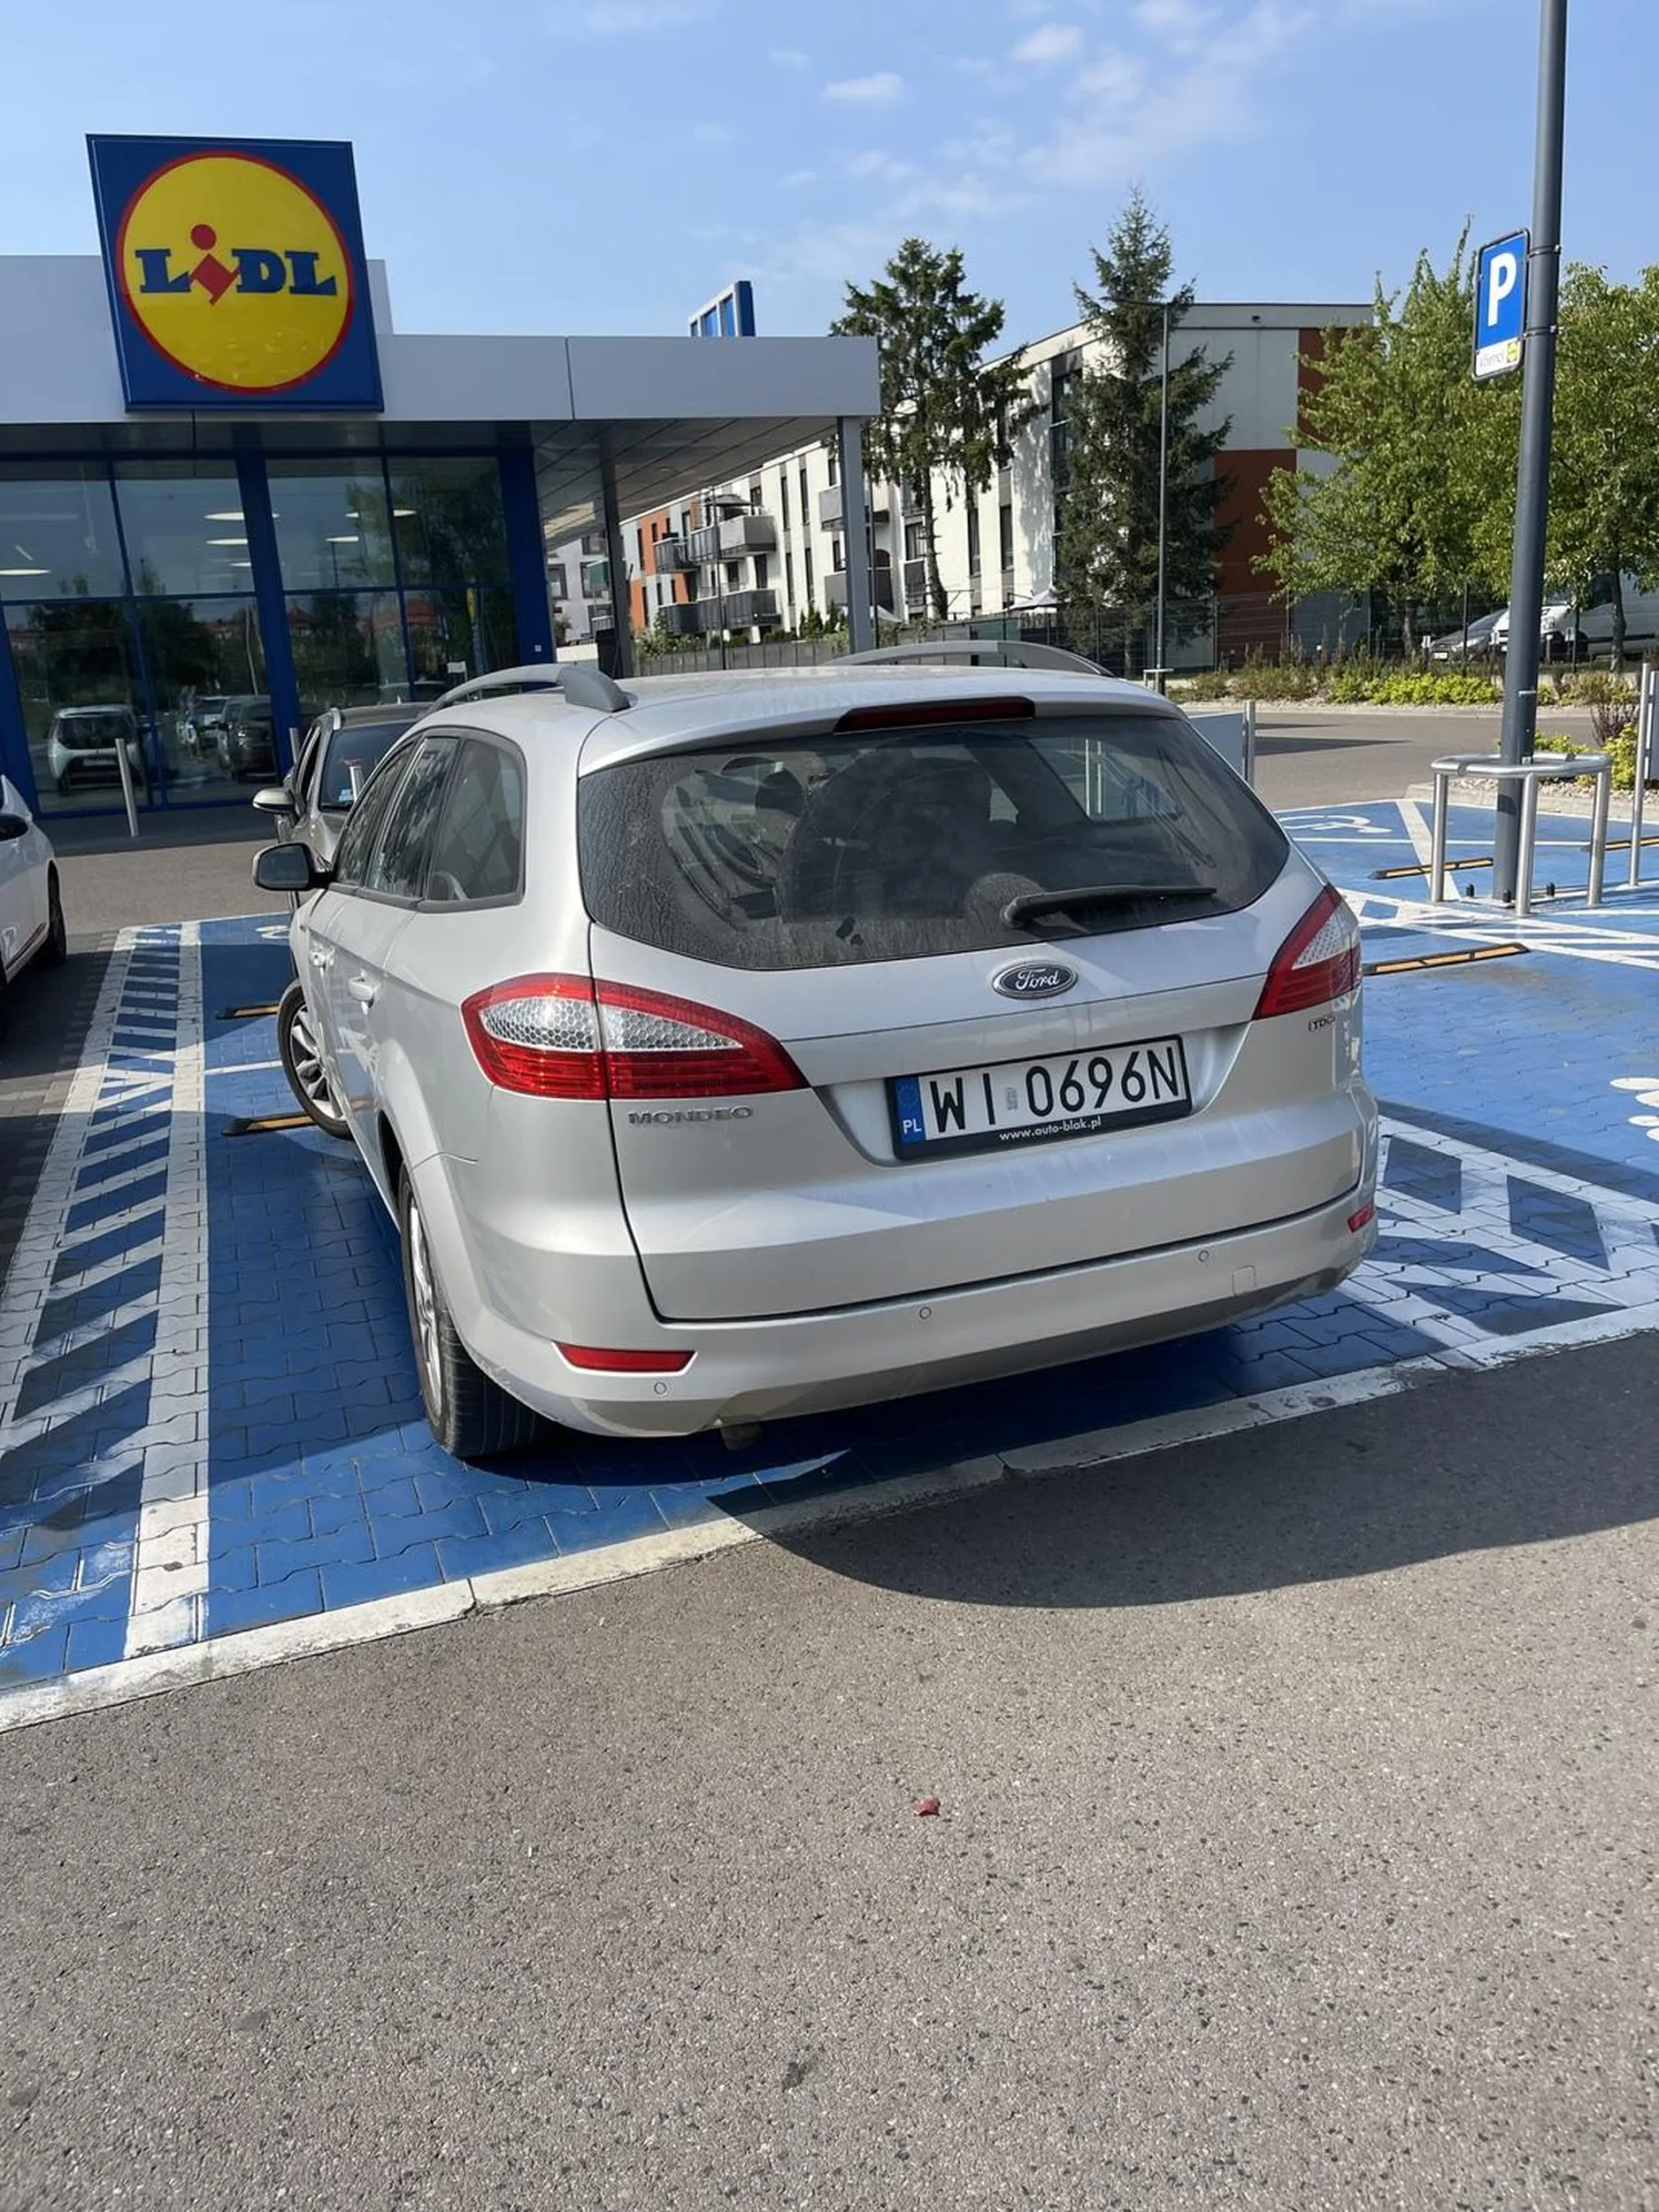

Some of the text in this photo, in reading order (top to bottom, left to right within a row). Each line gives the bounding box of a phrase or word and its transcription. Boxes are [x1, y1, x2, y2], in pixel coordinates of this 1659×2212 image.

[1487, 252, 1517, 327] P
[1015, 968, 1062, 990] Ford
[930, 1046, 1180, 1133] WI 0696N
[628, 1105, 754, 1125] MONDEO
[902, 1118, 922, 1134] PL
